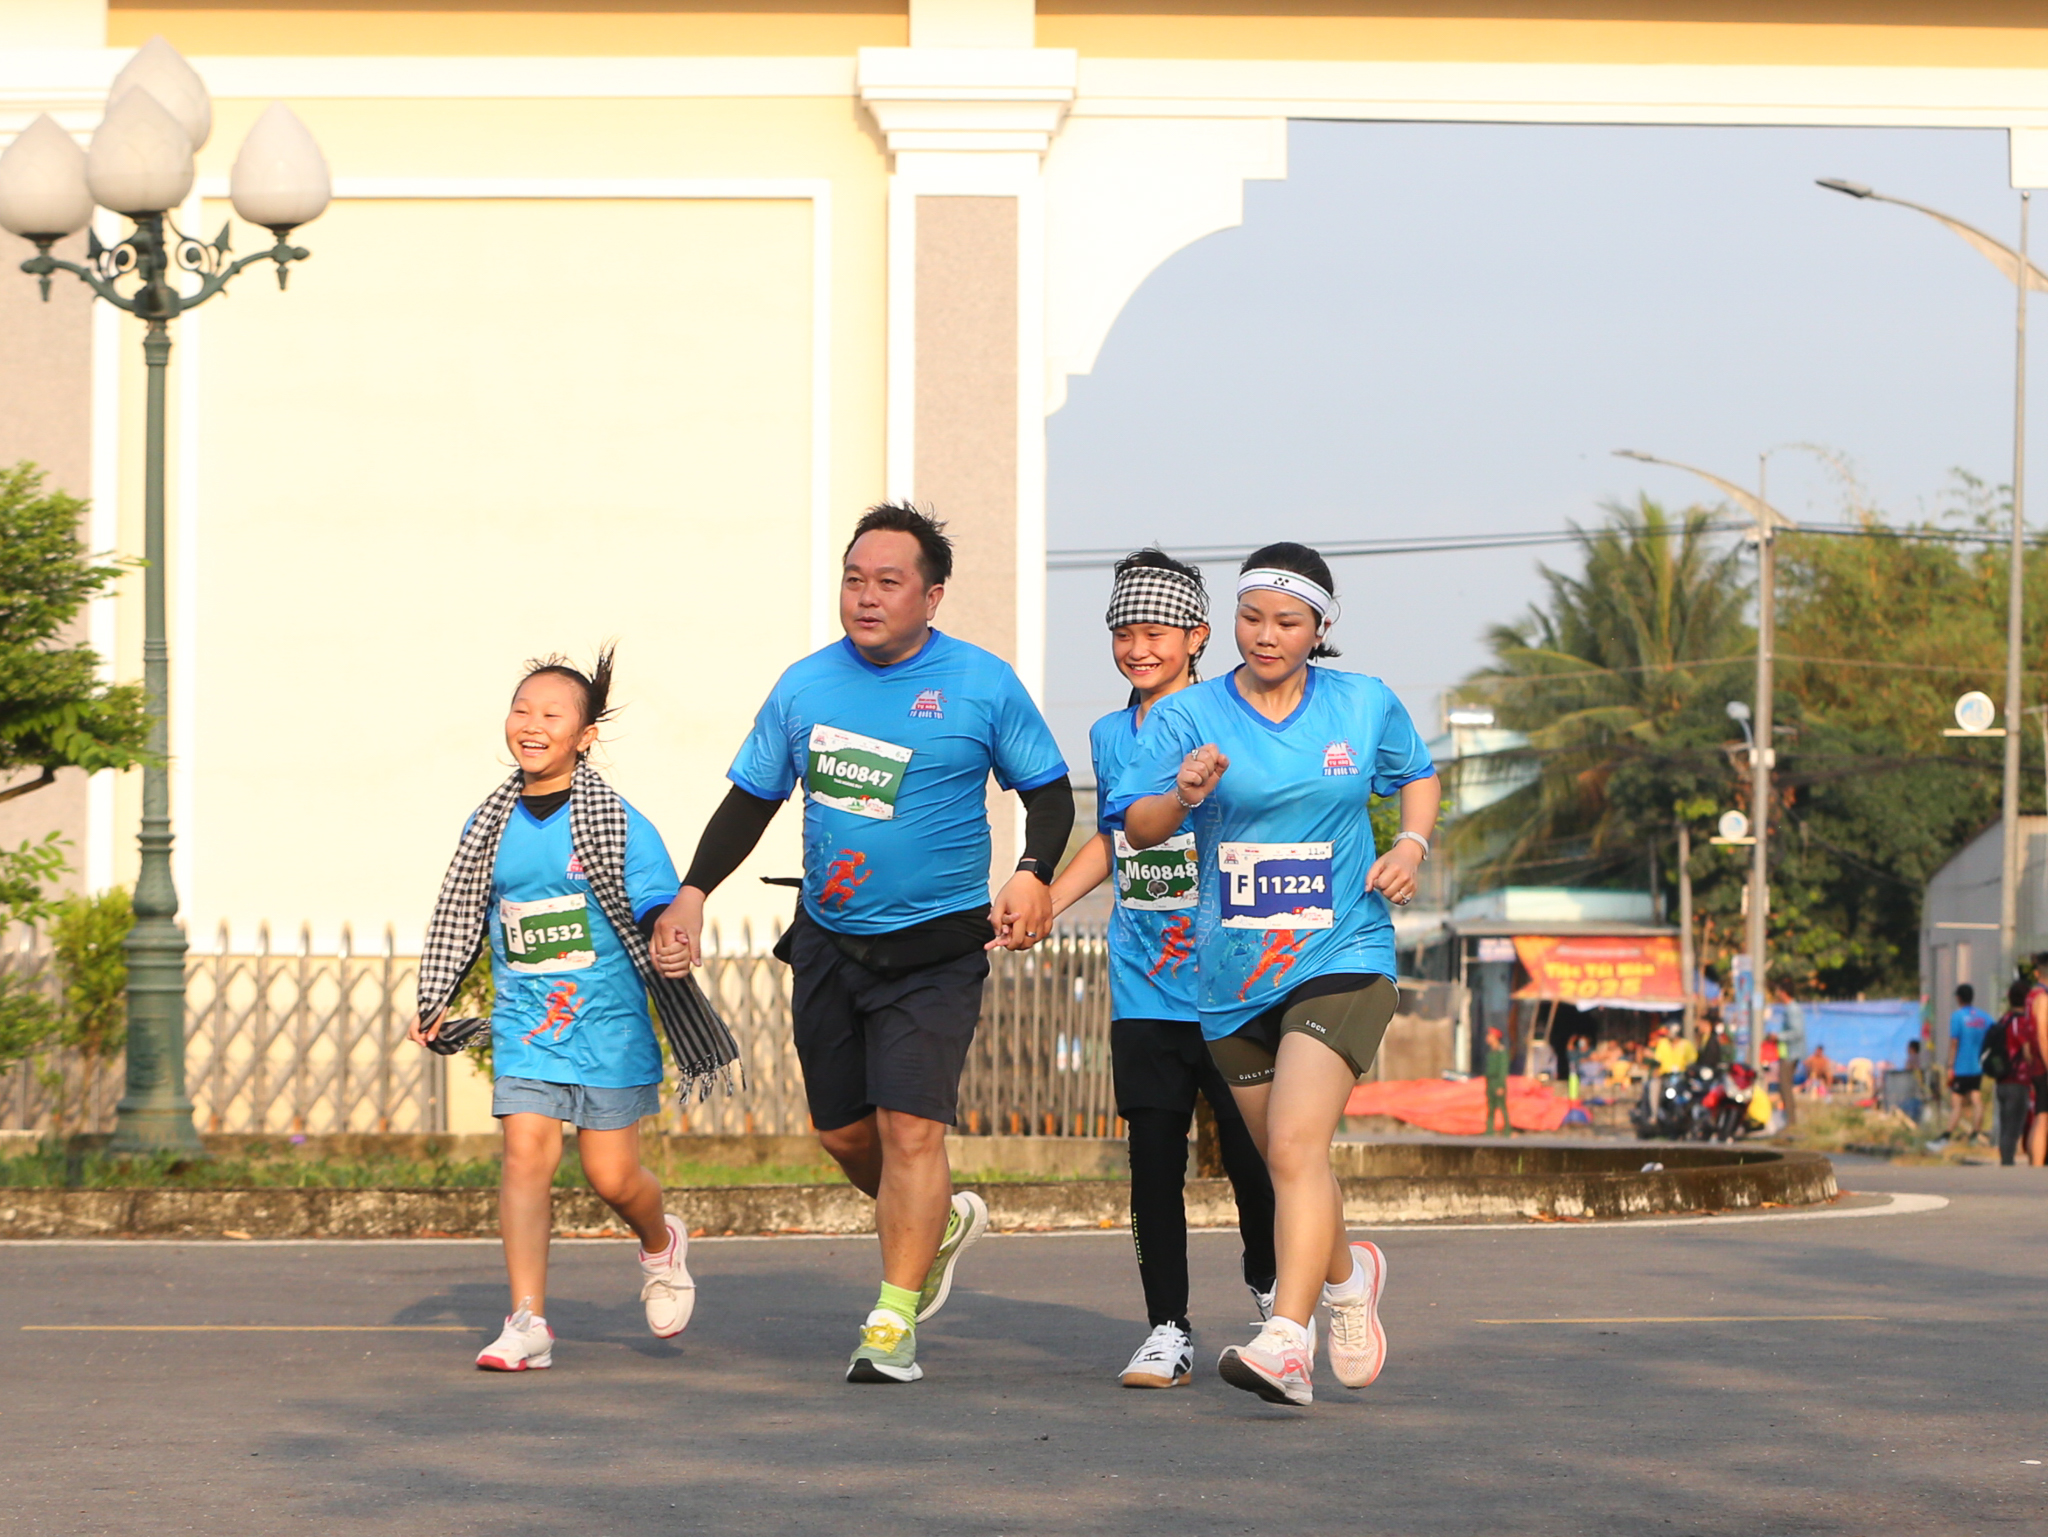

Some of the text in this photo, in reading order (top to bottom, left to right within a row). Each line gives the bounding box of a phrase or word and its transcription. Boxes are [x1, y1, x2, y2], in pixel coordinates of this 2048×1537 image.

[816, 754, 894, 788] M60847
[1125, 860, 1199, 881] M60848
[1258, 875, 1326, 894] 11224
[524, 923, 584, 944] 61532
[1559, 977, 1642, 998] 2025
